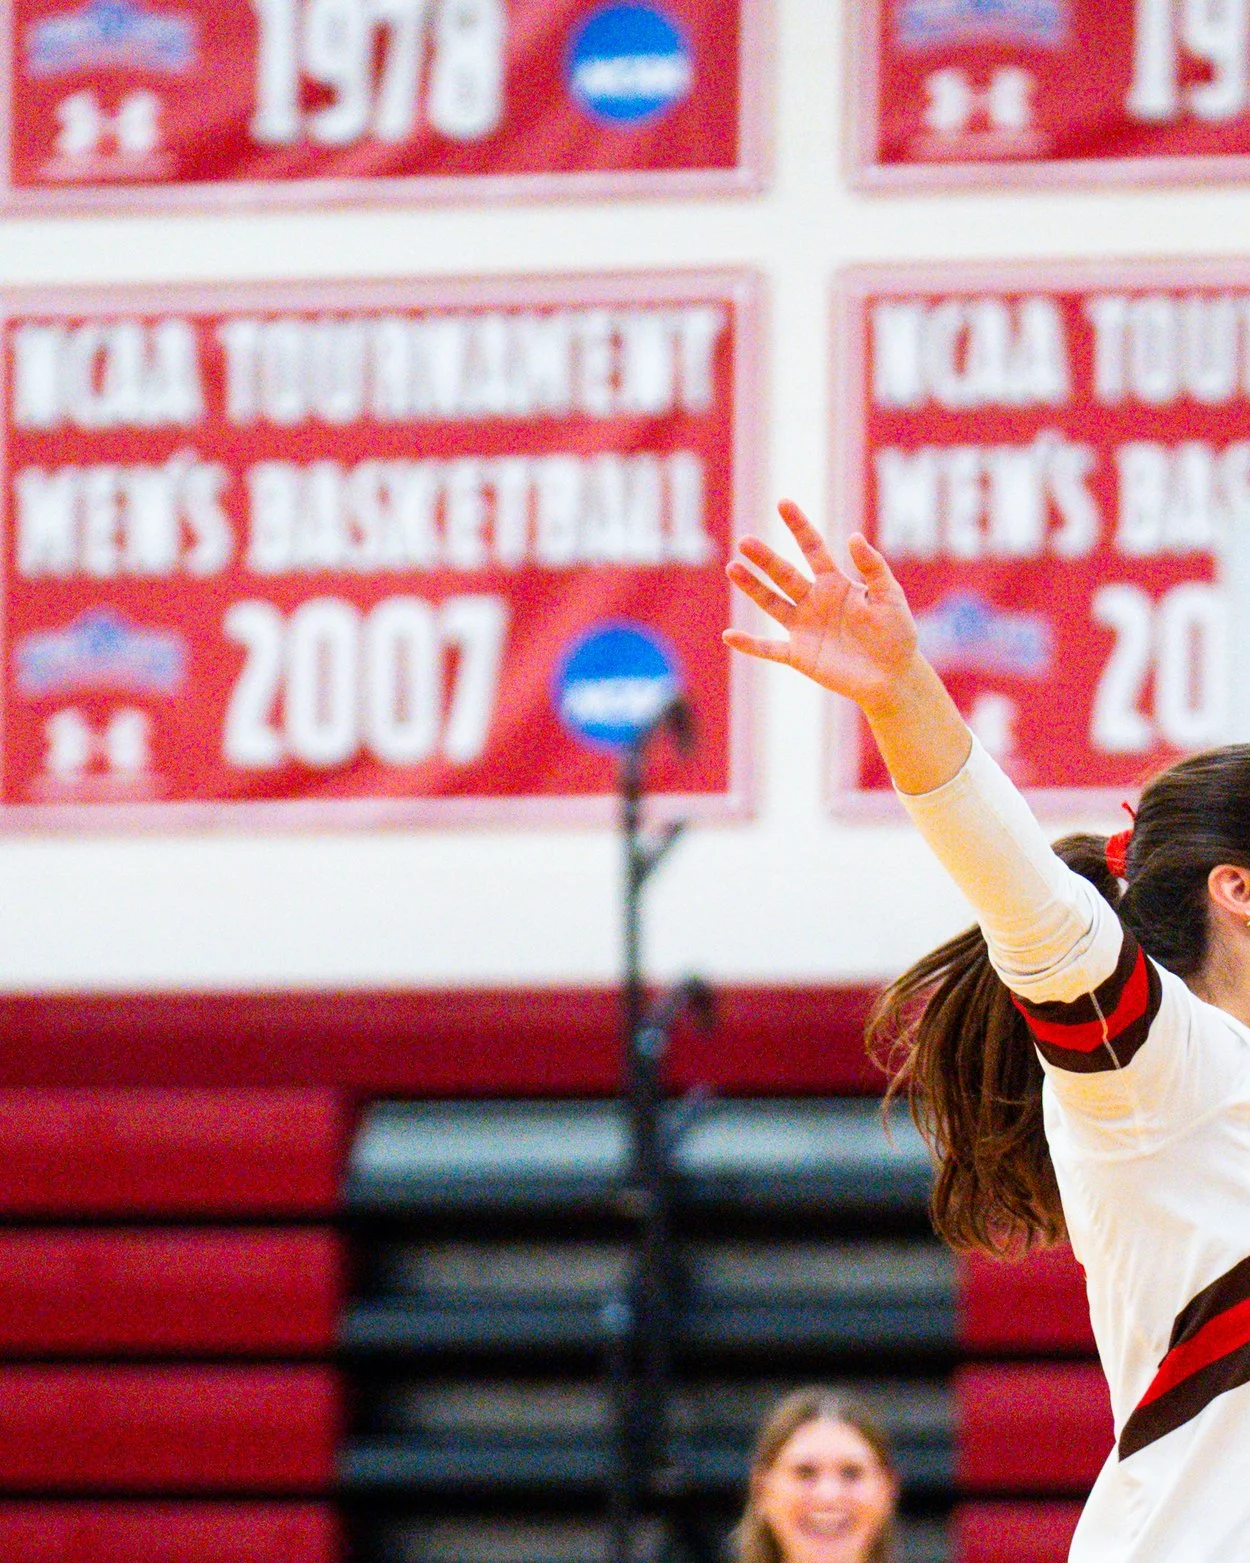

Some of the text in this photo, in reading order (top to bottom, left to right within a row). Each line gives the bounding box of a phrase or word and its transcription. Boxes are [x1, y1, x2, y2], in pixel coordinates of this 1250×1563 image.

[251, 0, 507, 143] 1978
[11, 307, 721, 429] NCAA TOURNAMENT
[869, 298, 1075, 403] NCAA
[12, 445, 718, 579] MEN'S BASKETBALL
[873, 430, 1102, 561] MEN'S
[222, 594, 509, 768] 2007
